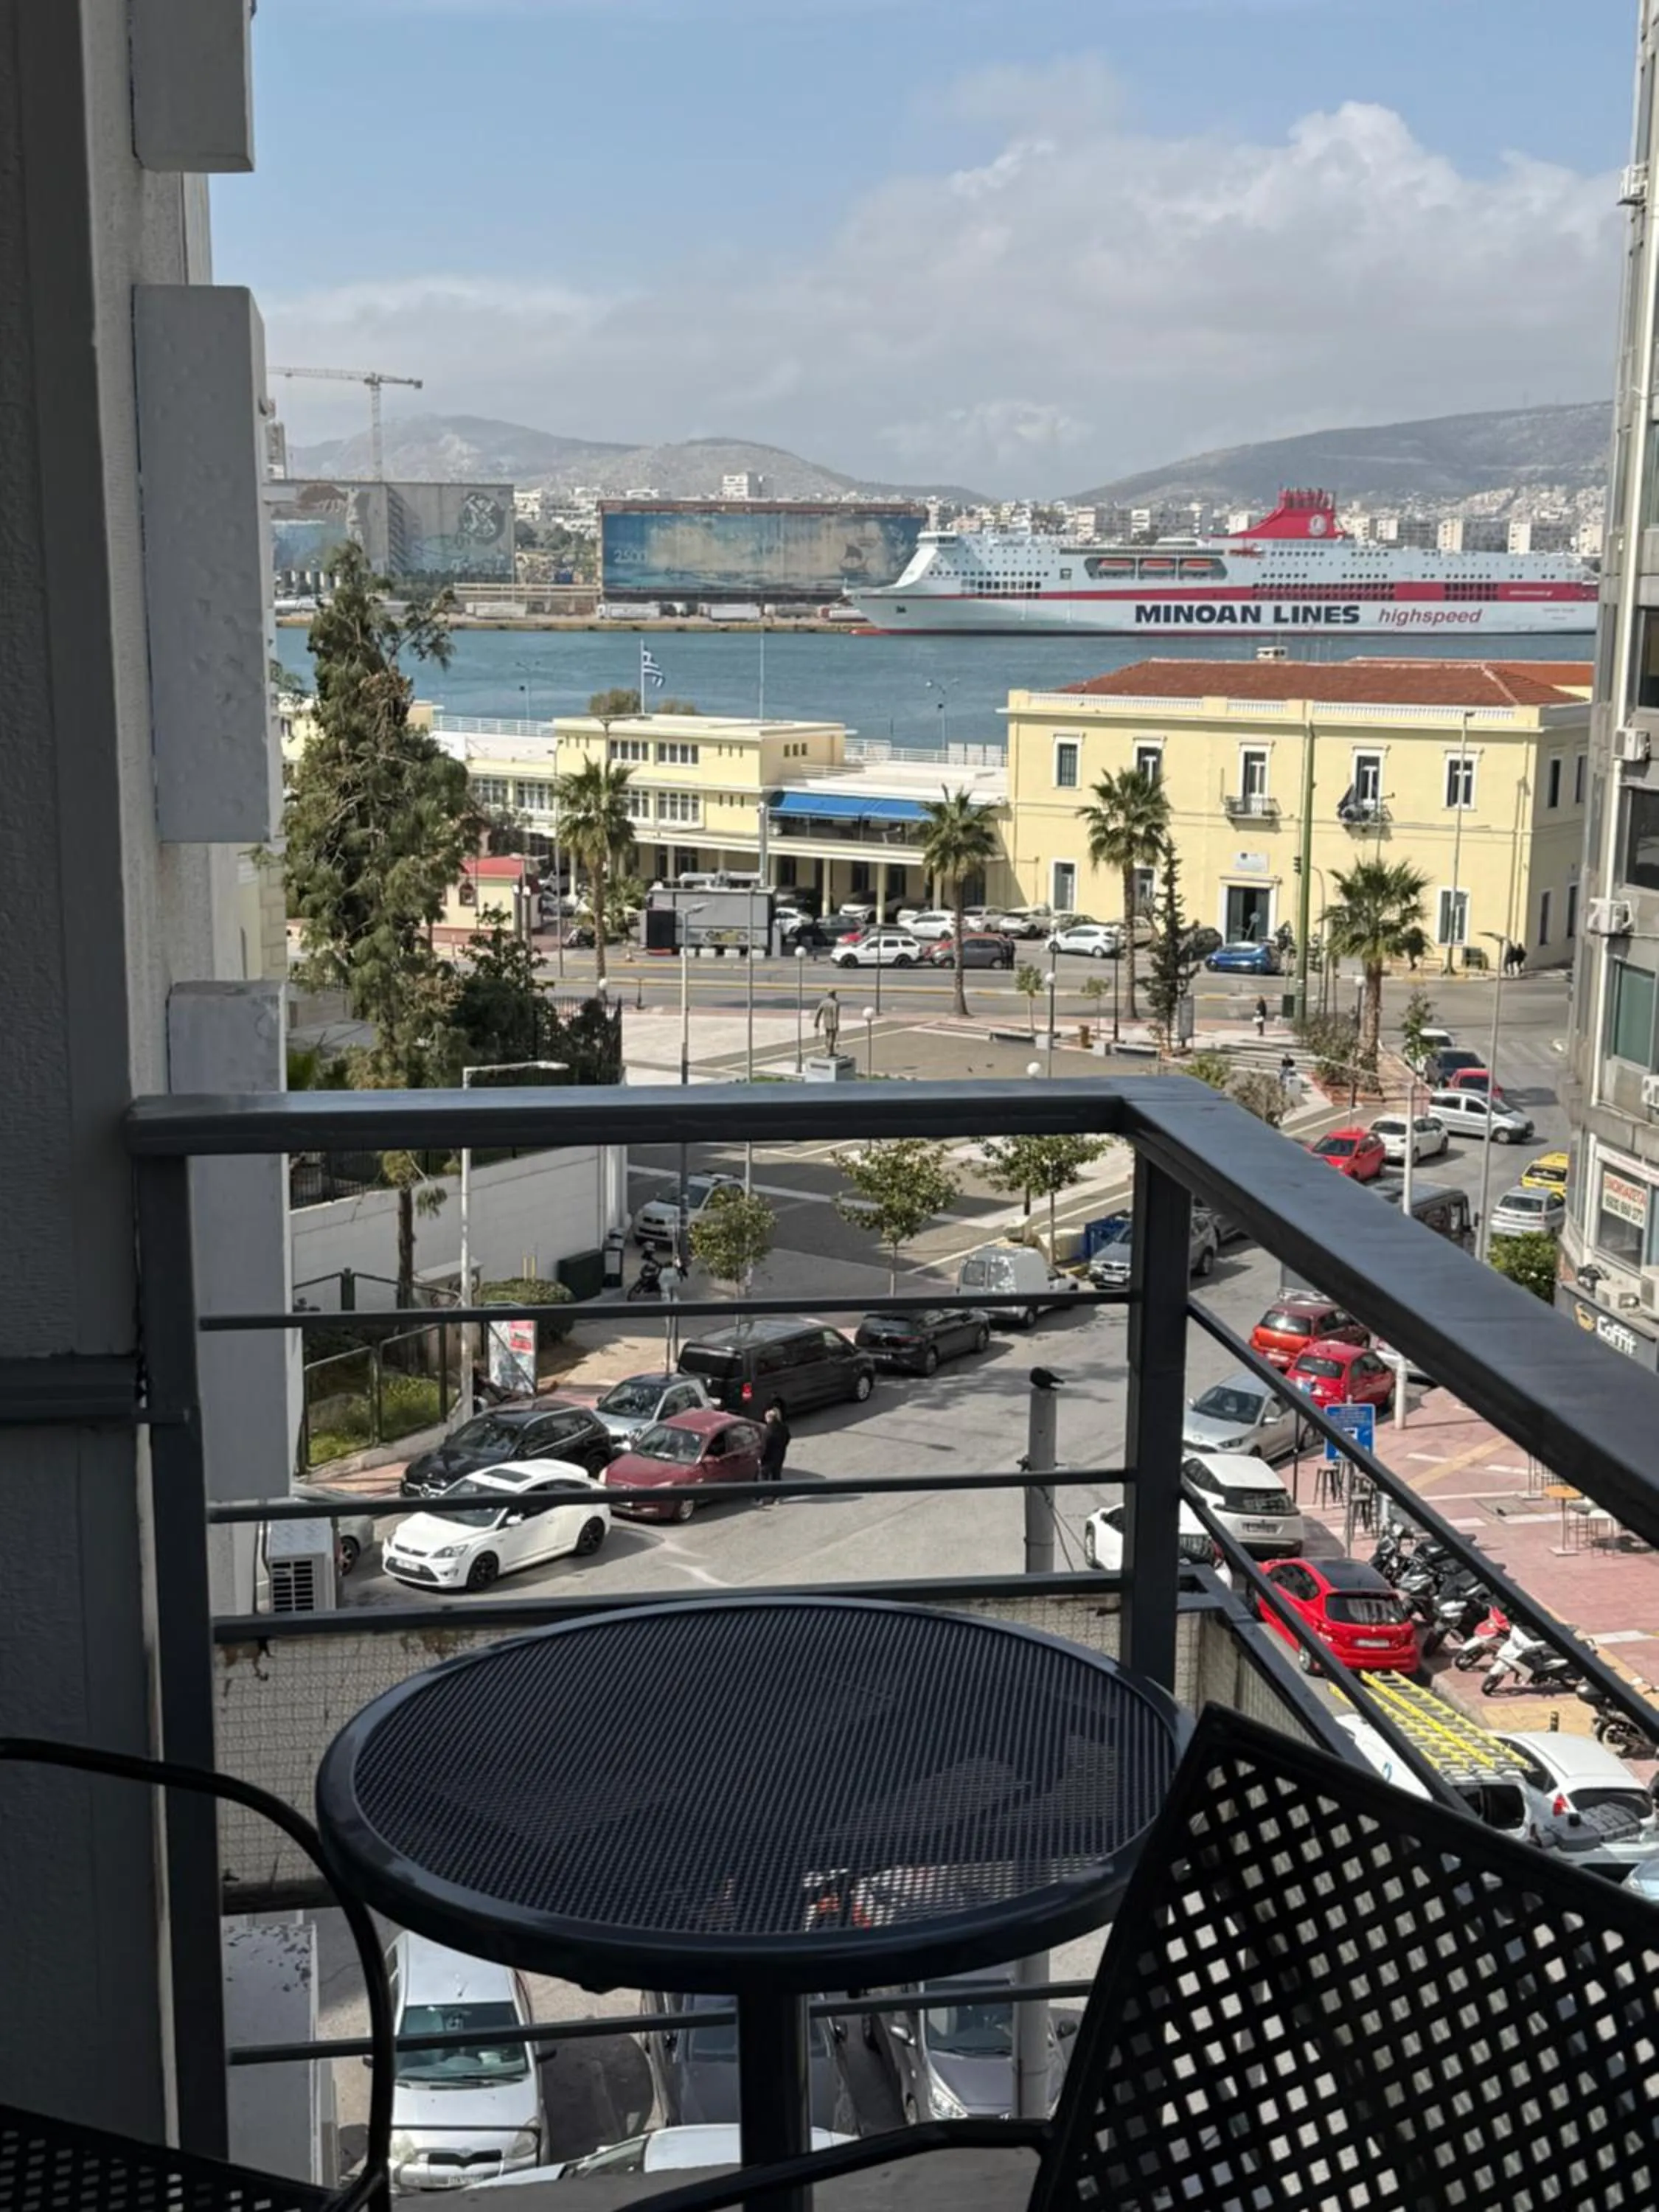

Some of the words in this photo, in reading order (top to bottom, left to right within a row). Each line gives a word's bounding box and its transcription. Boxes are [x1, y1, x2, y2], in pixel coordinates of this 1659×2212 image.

[1135, 604, 1261, 623] MINOAN
[1273, 605, 1360, 624] LINES
[1378, 608, 1483, 626] highspeed
